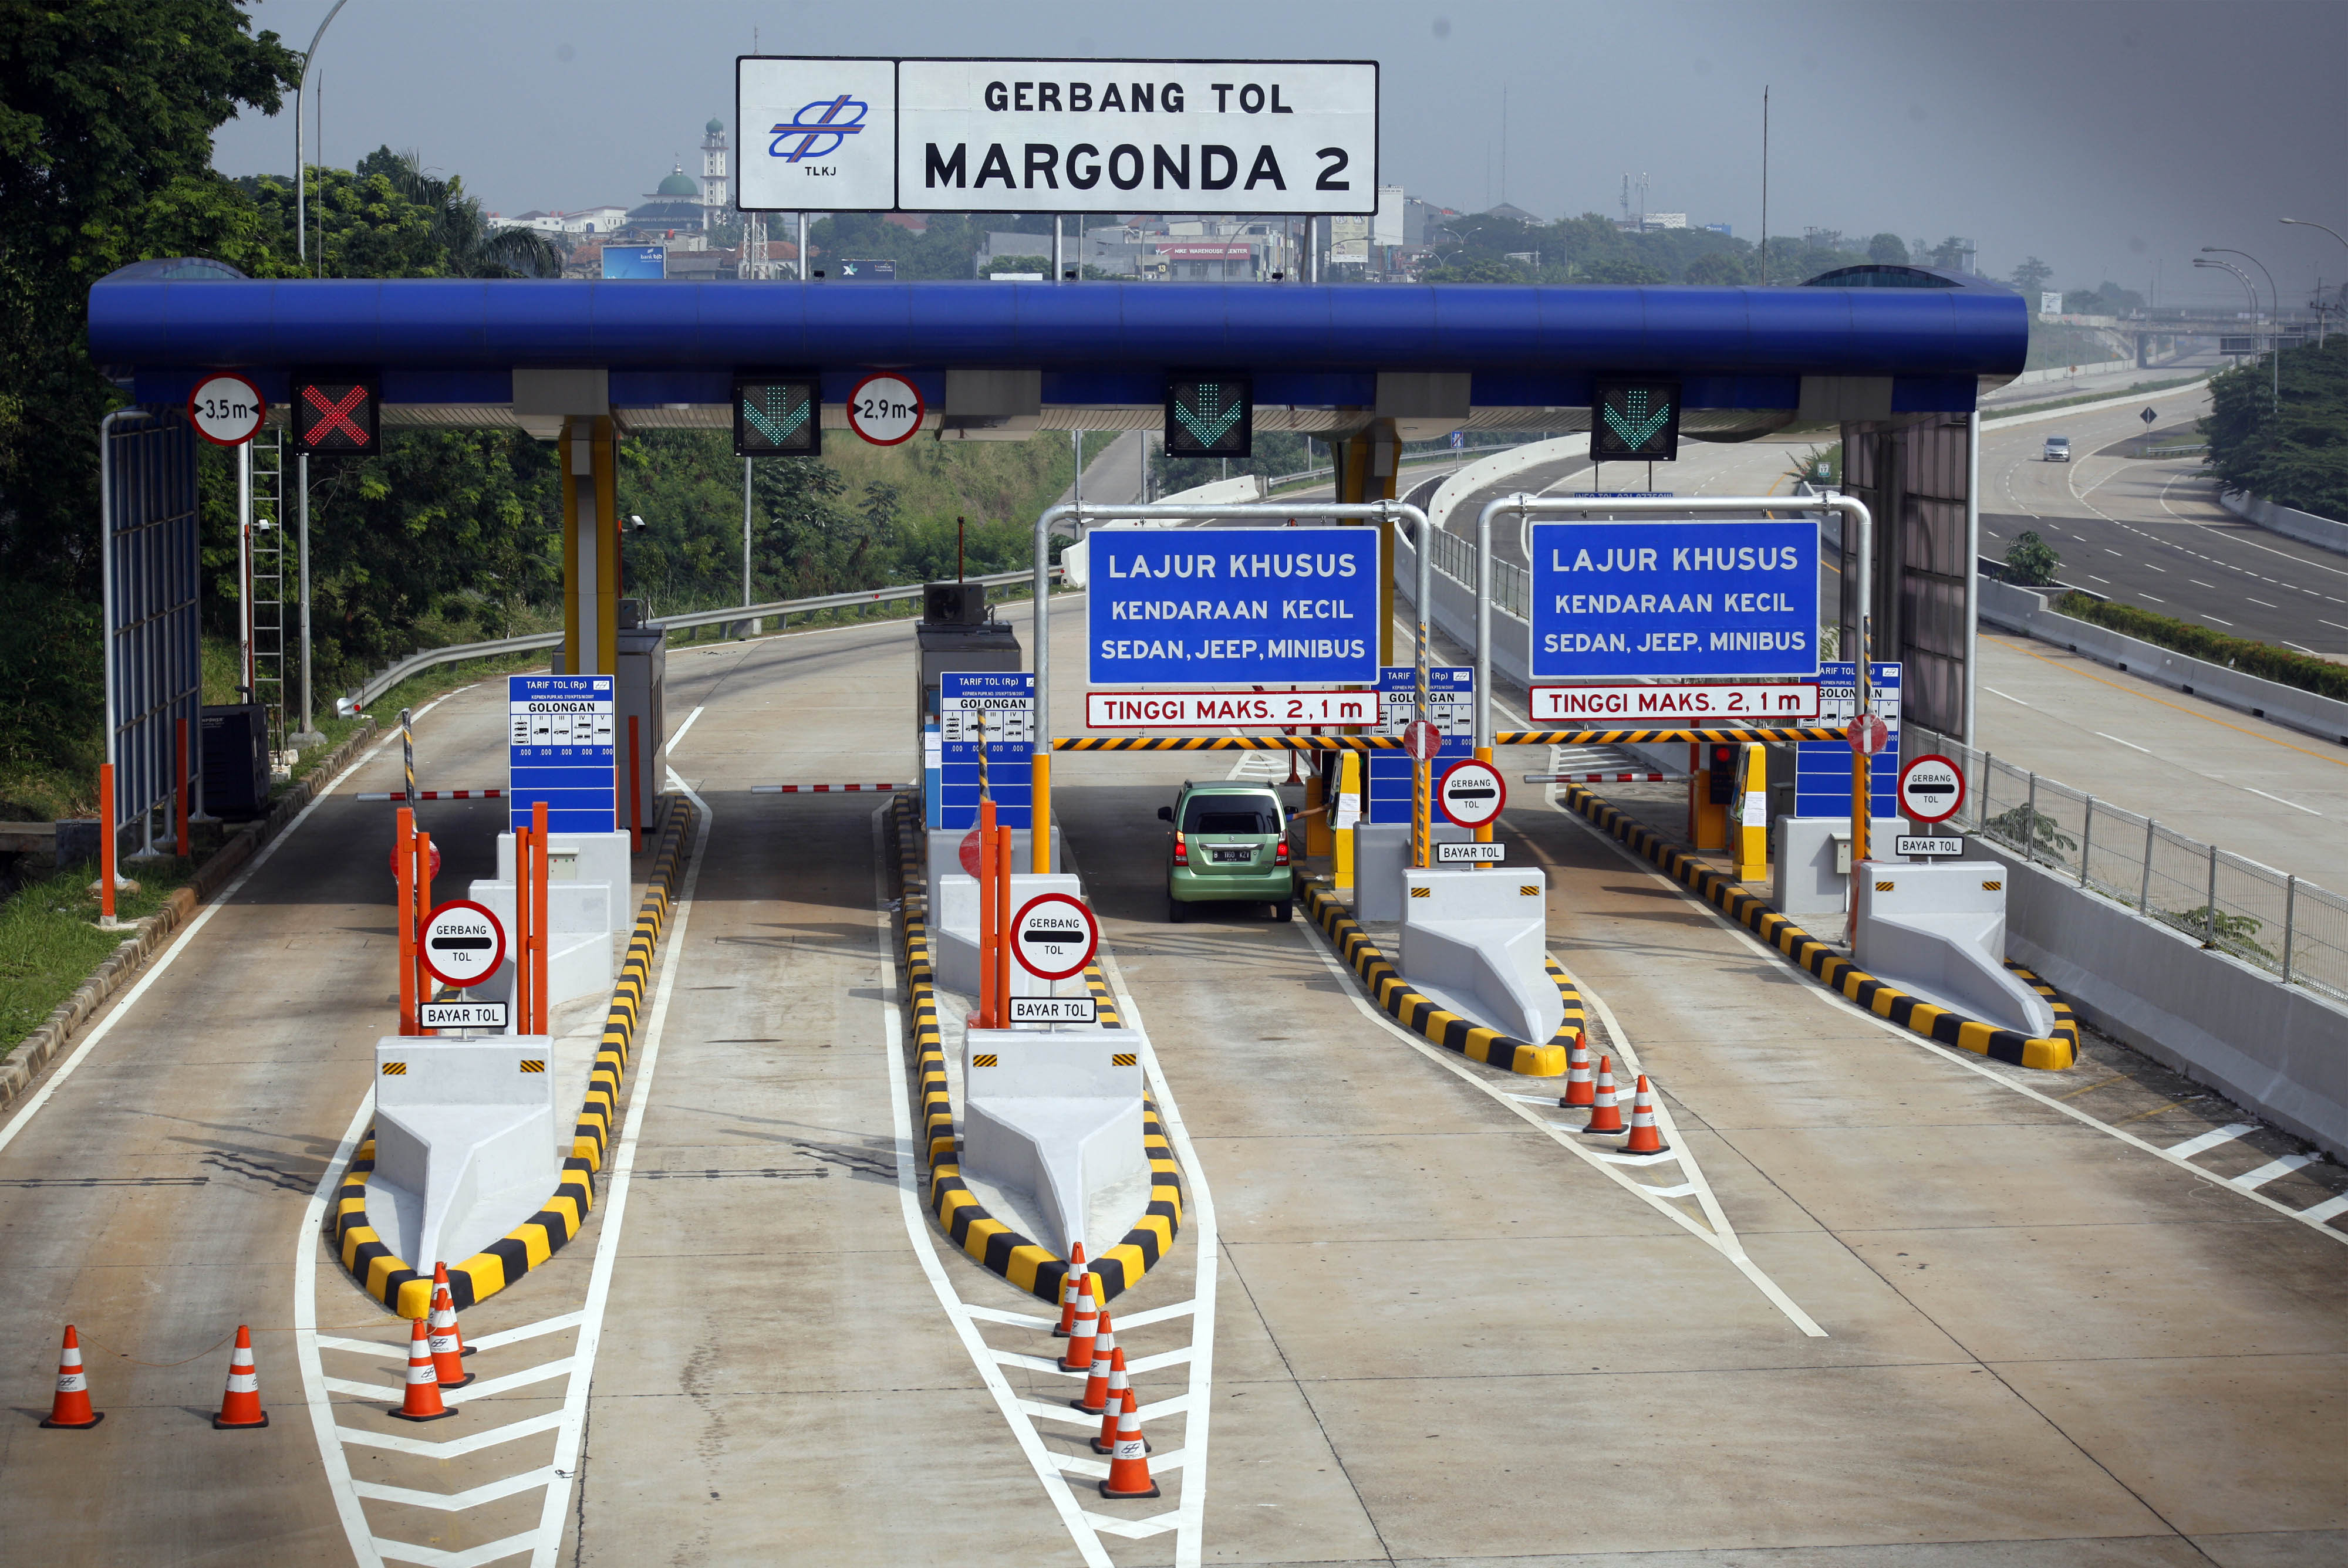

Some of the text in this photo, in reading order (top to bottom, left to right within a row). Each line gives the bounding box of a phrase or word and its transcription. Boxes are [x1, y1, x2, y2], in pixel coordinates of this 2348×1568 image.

[985, 82, 1293, 113] GERBANG TOL
[805, 167, 836, 175] TLKJ
[926, 143, 1349, 190] MARGONDA 2
[233, 404, 247, 418] m
[893, 404, 906, 418] m
[1110, 554, 1356, 577] LAJUR KHUSUS
[1553, 547, 1797, 572] LAJUR KHUSUS
[1556, 593, 1794, 613] KENDARAAN KECIL
[1113, 600, 1353, 619] KENDARAAN KECIL
[1544, 631, 1805, 653] SEDAN, JEEP, MINIBUS
[1269, 640, 1364, 658] MINIBUS
[1432, 673, 1448, 681] (Rp)
[571, 681, 586, 690] (Rp)
[1389, 693, 1455, 702] GOLGAN
[1820, 688, 1882, 698] GOLONN
[529, 703, 594, 712] GOLONGAN
[1550, 692, 1800, 712] TINGGI MAKS. 2,1 m
[1104, 699, 1362, 719] TINGGI MAKS. 2,1 m
[1445, 847, 1499, 857] BAYAR TOL
[1903, 841, 1956, 851] BAYAR TOL
[1030, 919, 1079, 928] GERBANG
[437, 926, 486, 934] GERBANG
[1045, 946, 1063, 954] TOL
[453, 952, 471, 961] TOL
[429, 1009, 498, 1022] BAYAR TOL
[1018, 1004, 1087, 1016] BAYAR TOL
